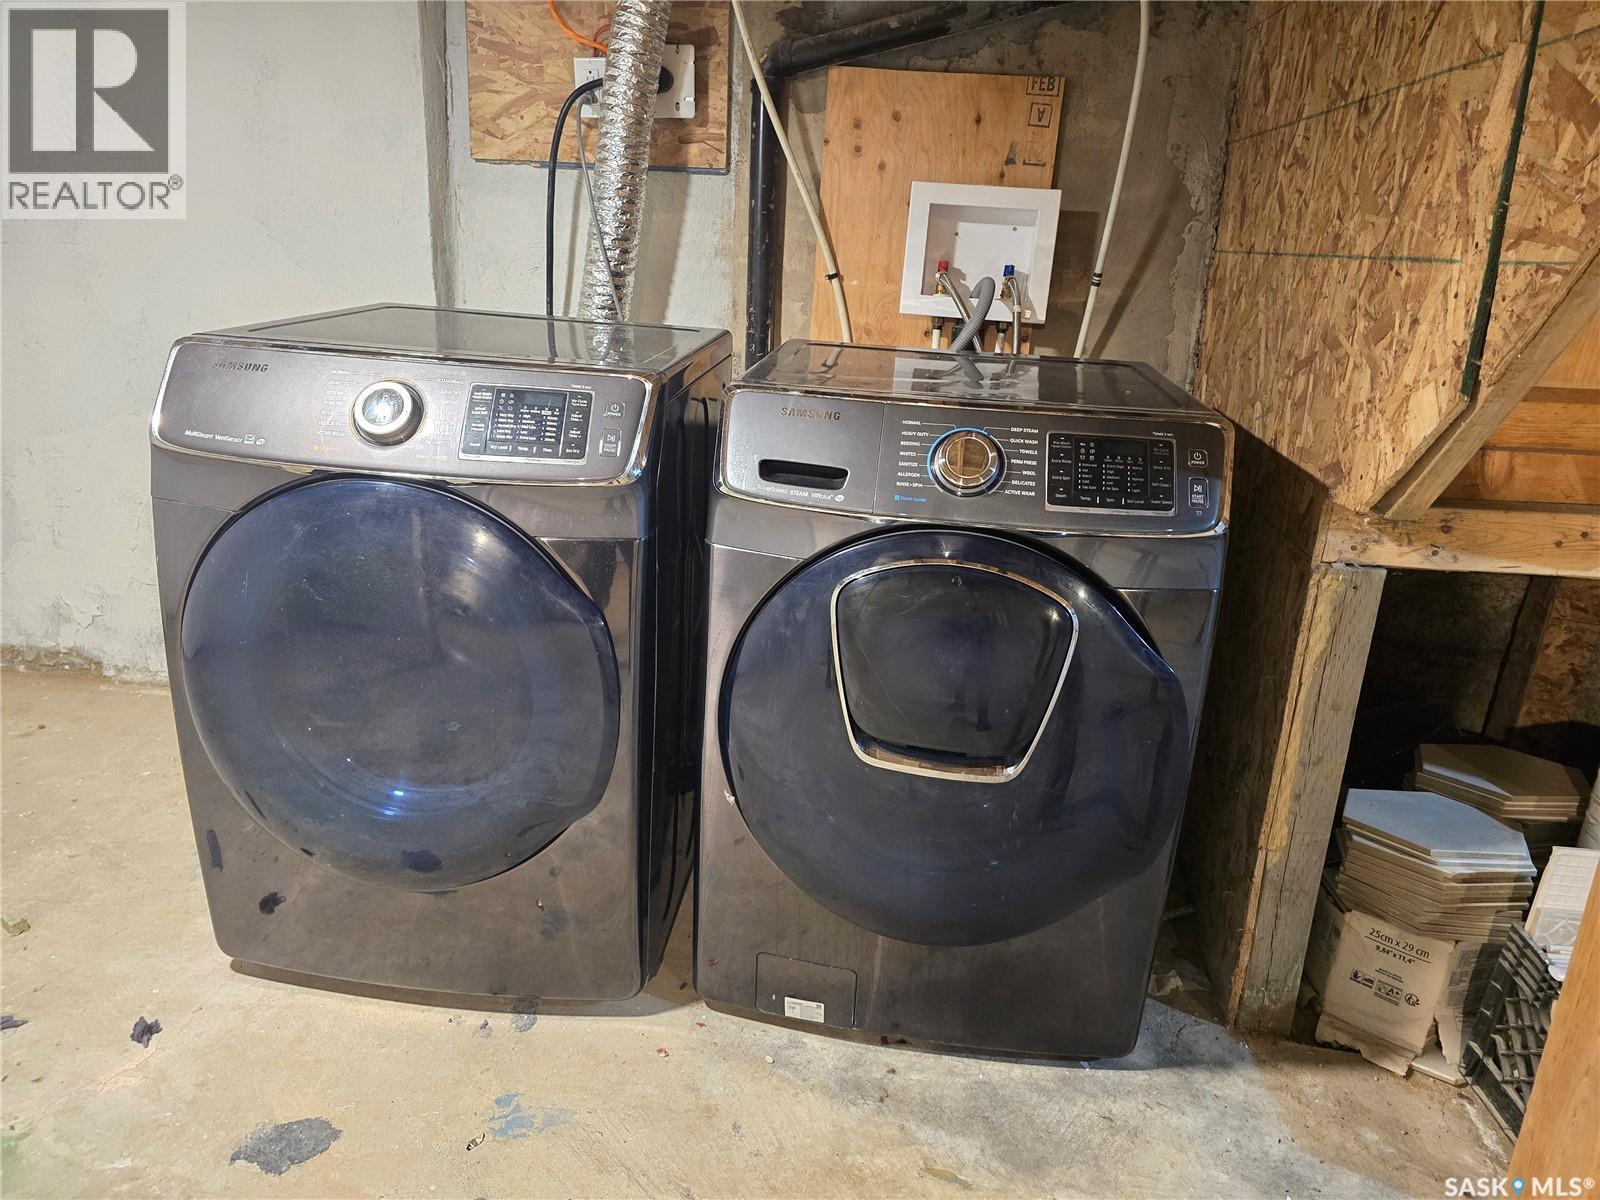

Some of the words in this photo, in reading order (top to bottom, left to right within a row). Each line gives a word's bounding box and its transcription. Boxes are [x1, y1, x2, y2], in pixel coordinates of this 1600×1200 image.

[1031, 75, 1056, 91] FEB
[212, 360, 269, 373] SAMSUNG
[781, 407, 841, 421] SAMSUNG
[790, 489, 809, 497] STEAM
[1369, 927, 1394, 945] 25cm
[1402, 941, 1415, 952] 29
[1415, 948, 1430, 959] cm
[1388, 987, 1401, 996] A+
